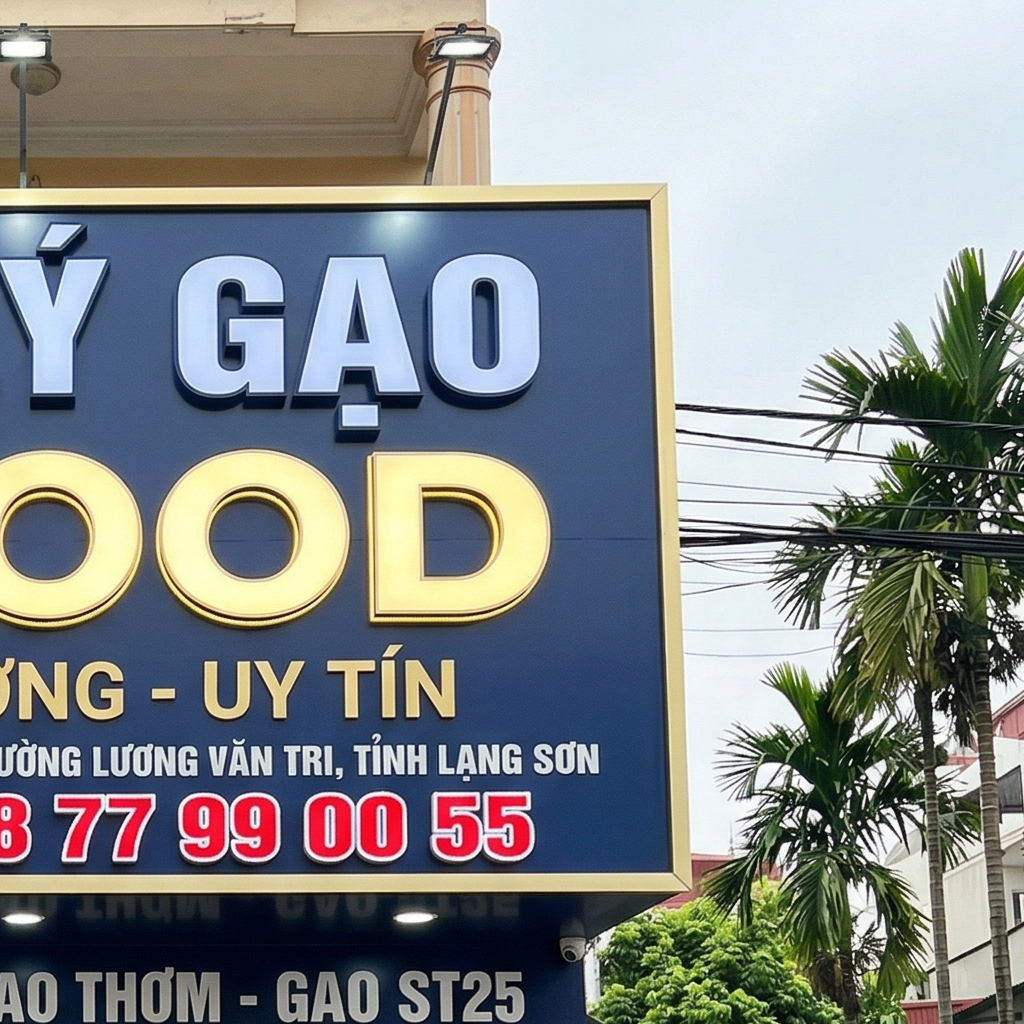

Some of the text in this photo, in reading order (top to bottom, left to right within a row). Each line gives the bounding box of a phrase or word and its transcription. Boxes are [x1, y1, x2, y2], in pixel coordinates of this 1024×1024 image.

[175, 253, 541, 434] GẠO
[203, 661, 304, 720] UY
[327, 644, 456, 718] TÍN
[92, 743, 198, 777] LƯƠNG
[208, 738, 273, 777] VĂN
[283, 744, 344, 780] TRI,
[353, 735, 428, 777] TỈNH
[438, 743, 523, 782] LẠNG
[533, 741, 600, 776] SƠN
[53, 793, 157, 863] 77
[177, 791, 282, 863] 99
[303, 791, 408, 863] 00
[430, 791, 536, 863] 55
[75, 966, 221, 1024] THƠM
[398, 970, 525, 1024] ST25
